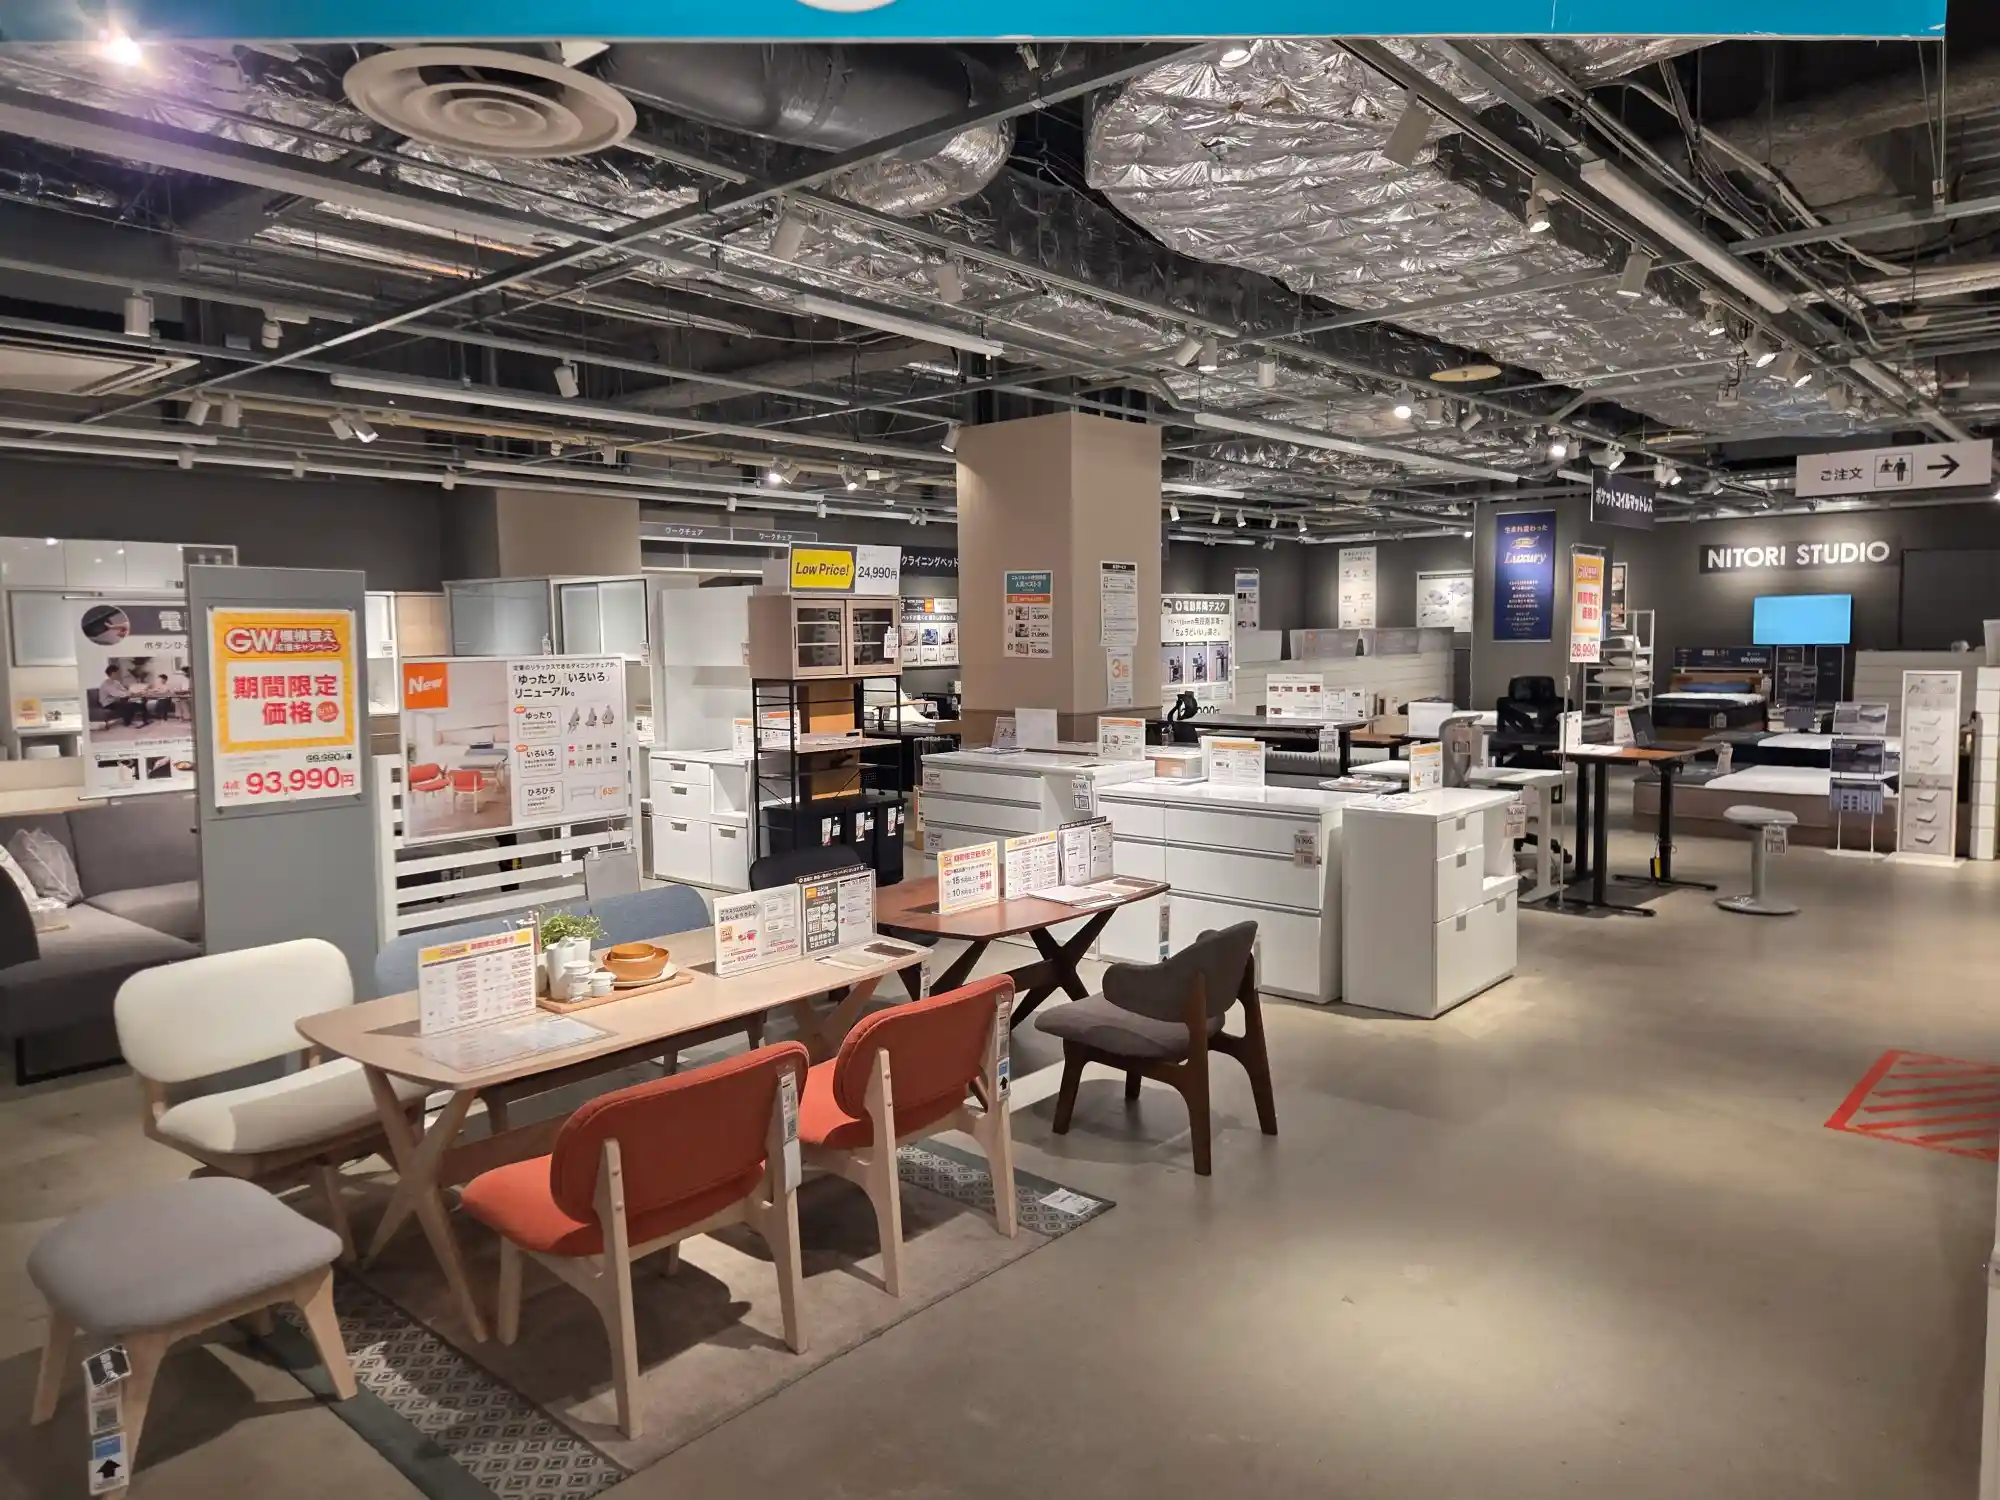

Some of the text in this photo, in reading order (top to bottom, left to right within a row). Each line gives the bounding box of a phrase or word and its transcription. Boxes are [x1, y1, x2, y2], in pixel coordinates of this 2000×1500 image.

[1820, 467, 1864, 482] ご注文
[1595, 486, 1654, 513] ポケットコイルマットレス
[665, 527, 704, 537] ワークチェア
[759, 532, 792, 541] ワークチェア
[1707, 541, 1890, 569] NITORI STUDIO
[795, 562, 849, 577] Low Price!
[858, 566, 898, 579] 24,990円
[224, 628, 278, 652] GW
[233, 674, 338, 699] 期間限定
[408, 676, 443, 694] New
[515, 687, 575, 698] リニューアル。
[262, 701, 313, 725] 価格
[525, 711, 553, 720] ゆったり
[526, 748, 555, 758] いろいろ
[245, 766, 355, 795] 93,990円
[527, 786, 556, 797] ひろひろ
